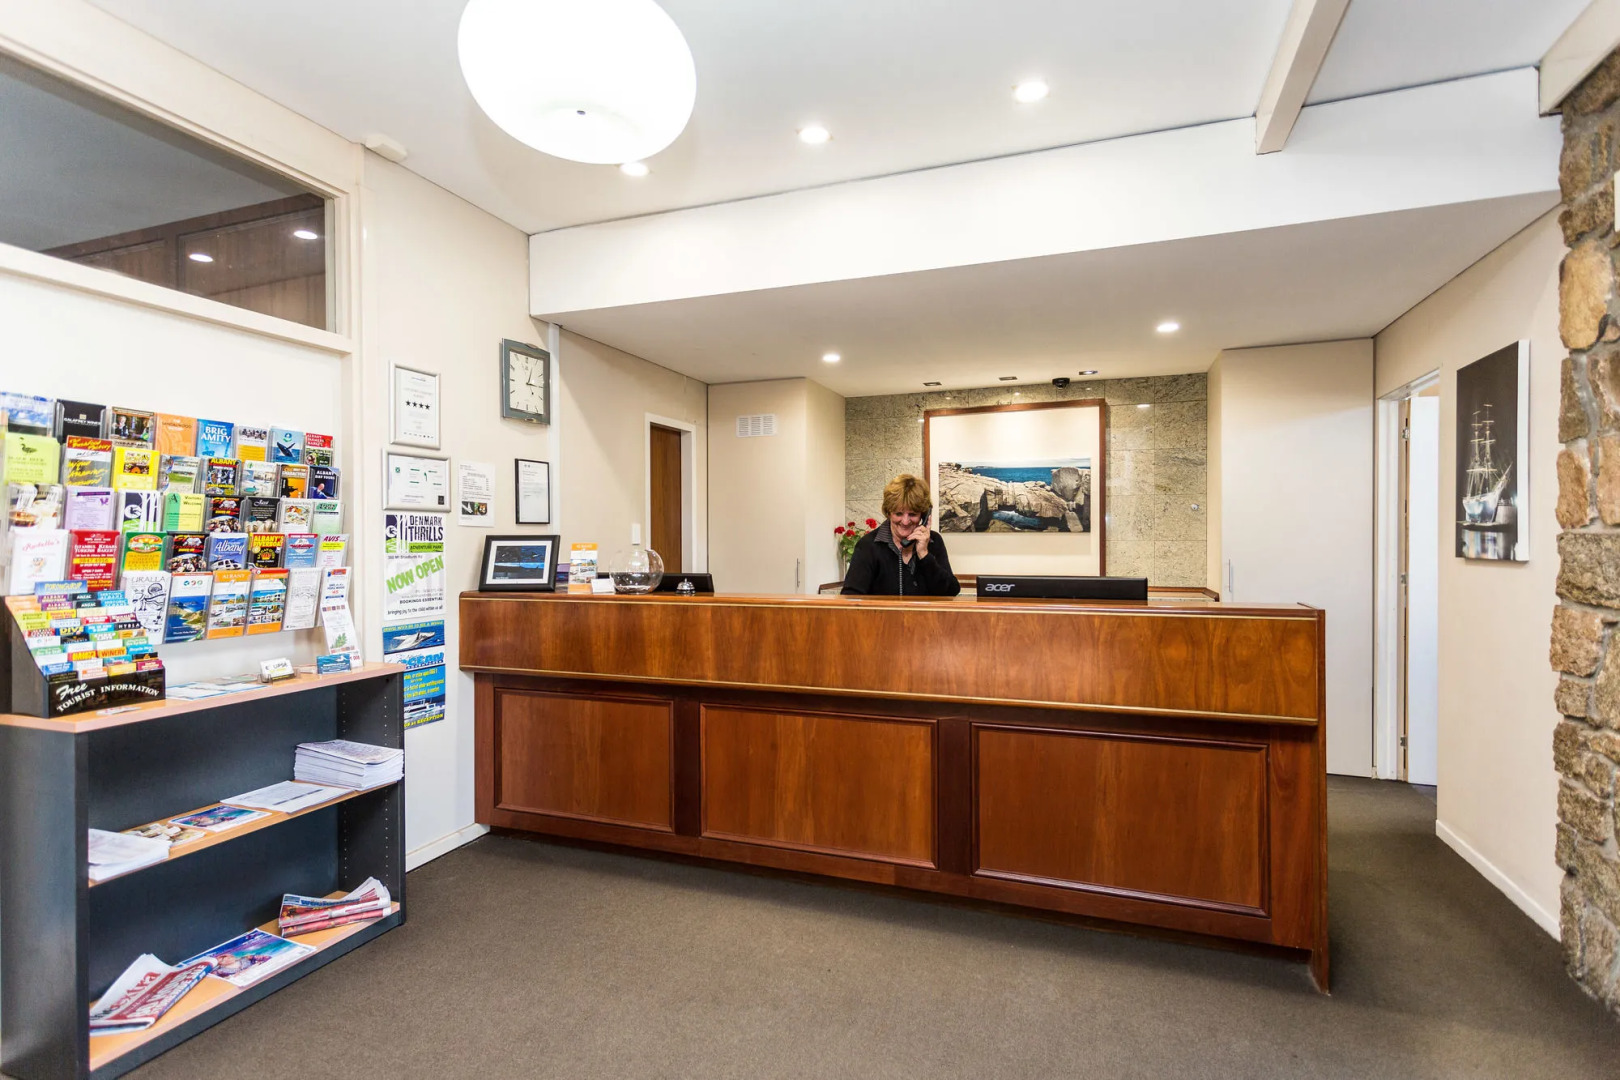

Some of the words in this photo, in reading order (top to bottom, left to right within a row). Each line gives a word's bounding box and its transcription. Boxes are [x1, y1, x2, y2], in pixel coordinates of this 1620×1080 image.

[205, 426, 227, 437] BRIG
[201, 433, 231, 443] AMITY
[211, 458, 237, 466] ALBANY
[410, 515, 442, 527] DENMARK
[253, 535, 283, 543] ALBANY'S
[214, 540, 244, 555] Albany
[386, 568, 415, 594] NOW
[415, 555, 444, 579] OPEN
[985, 583, 1016, 592] acer
[102, 649, 125, 658] WINERY
[56, 682, 89, 701] Free
[56, 689, 97, 712] TOURIST
[101, 683, 160, 697] INFORMATION
